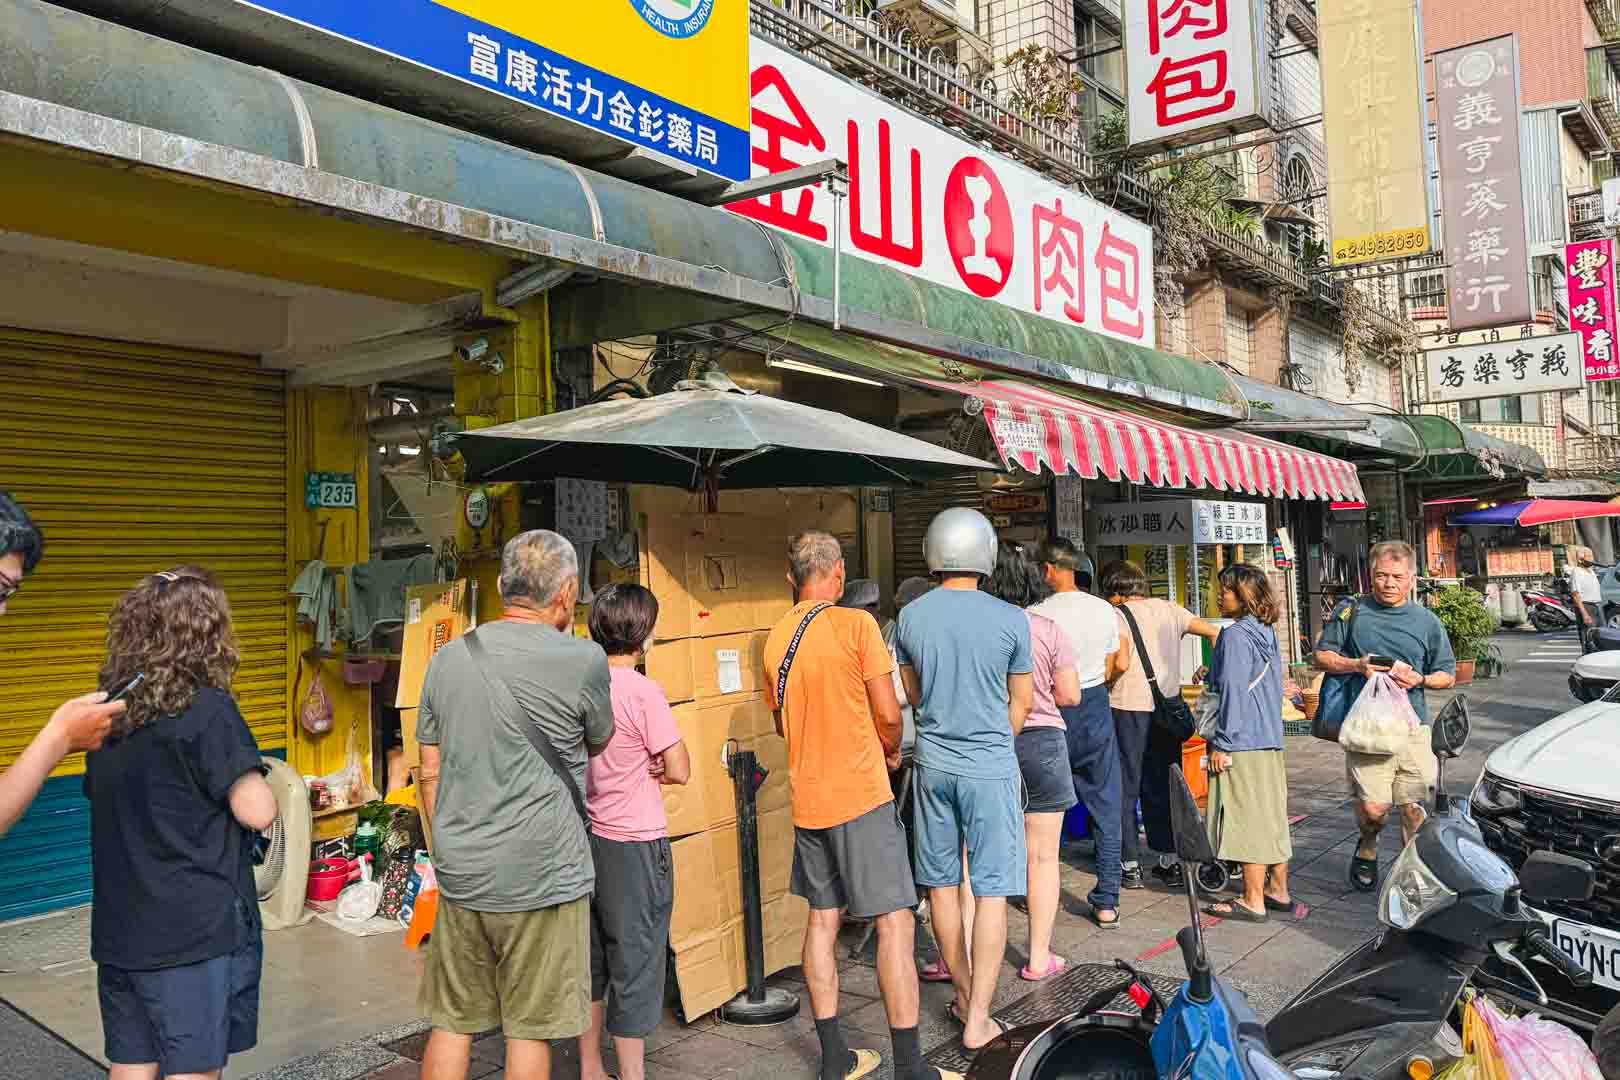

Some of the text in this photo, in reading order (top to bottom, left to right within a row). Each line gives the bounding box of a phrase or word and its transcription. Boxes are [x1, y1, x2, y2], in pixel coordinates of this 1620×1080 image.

[641, 4, 680, 36] HEALTH
[1147, 0, 1236, 127] 肉包
[721, 64, 1144, 339] 金山 肉包
[323, 485, 353, 503] 235
